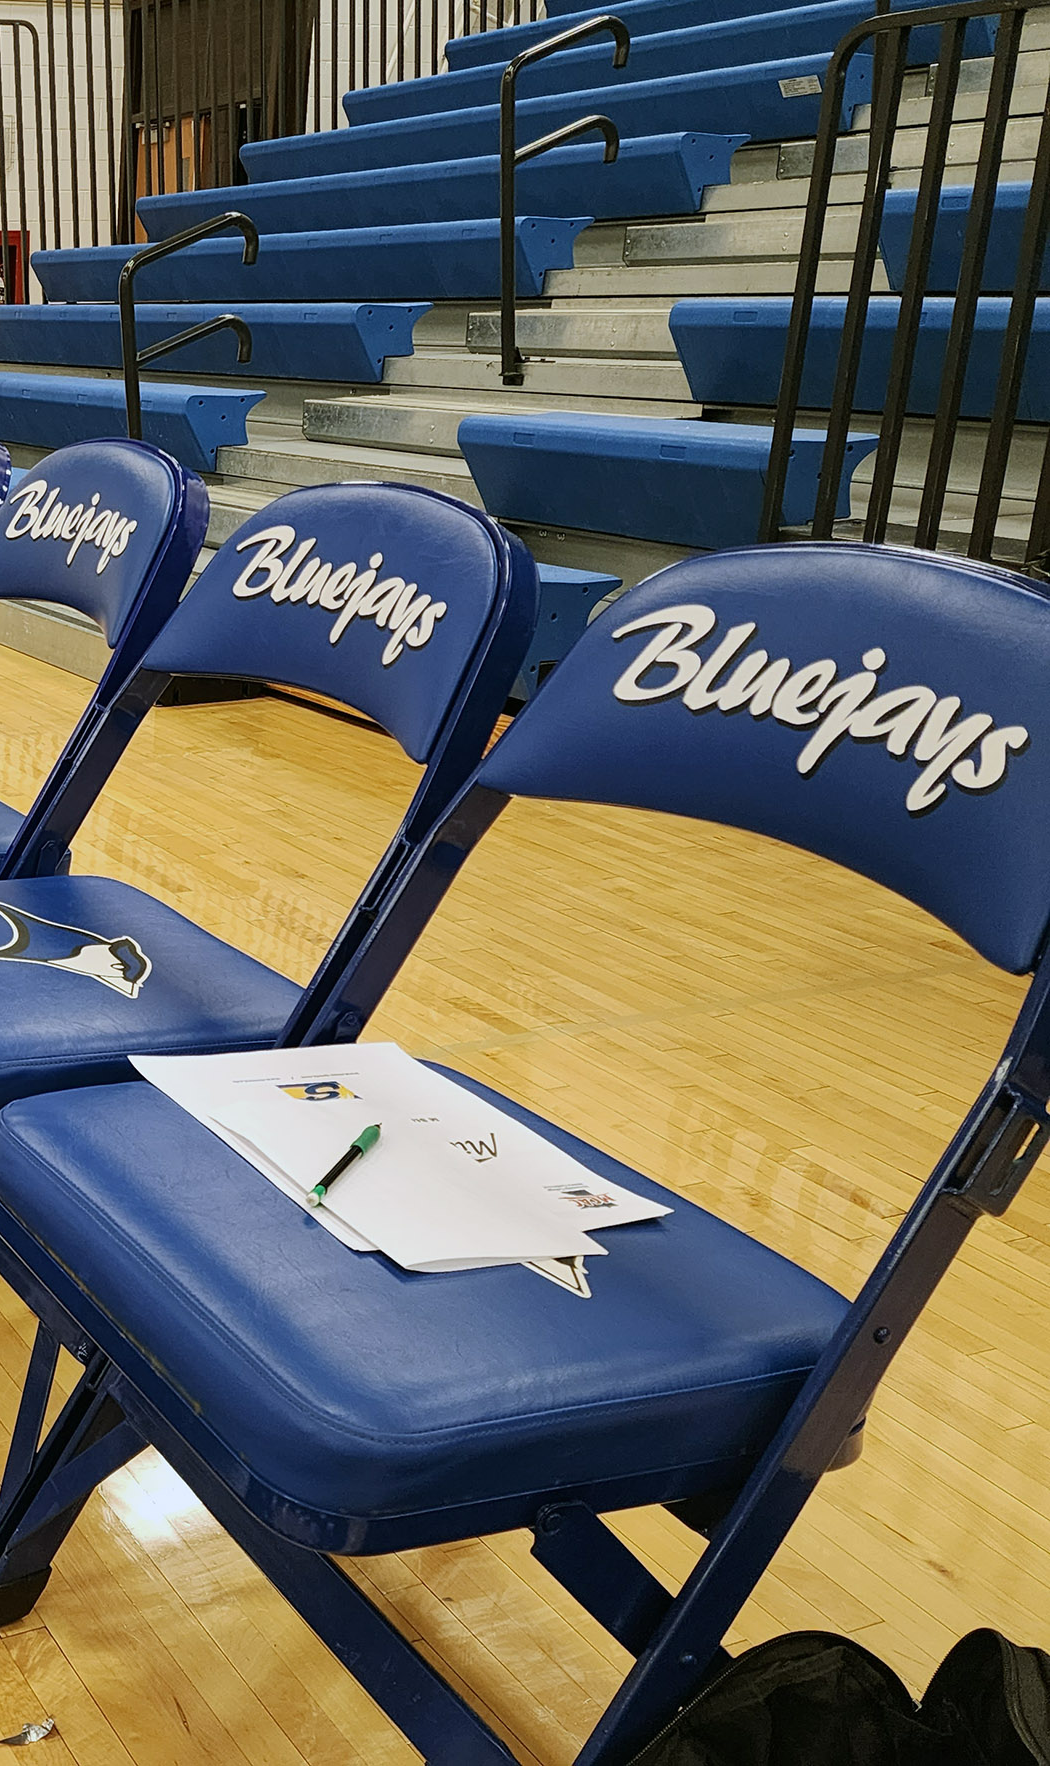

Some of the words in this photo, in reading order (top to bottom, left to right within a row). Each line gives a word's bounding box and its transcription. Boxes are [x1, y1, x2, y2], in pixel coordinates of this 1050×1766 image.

[5, 479, 138, 574] Bluejays
[232, 525, 447, 666] Bluejays
[612, 604, 1029, 812] Bluejays
